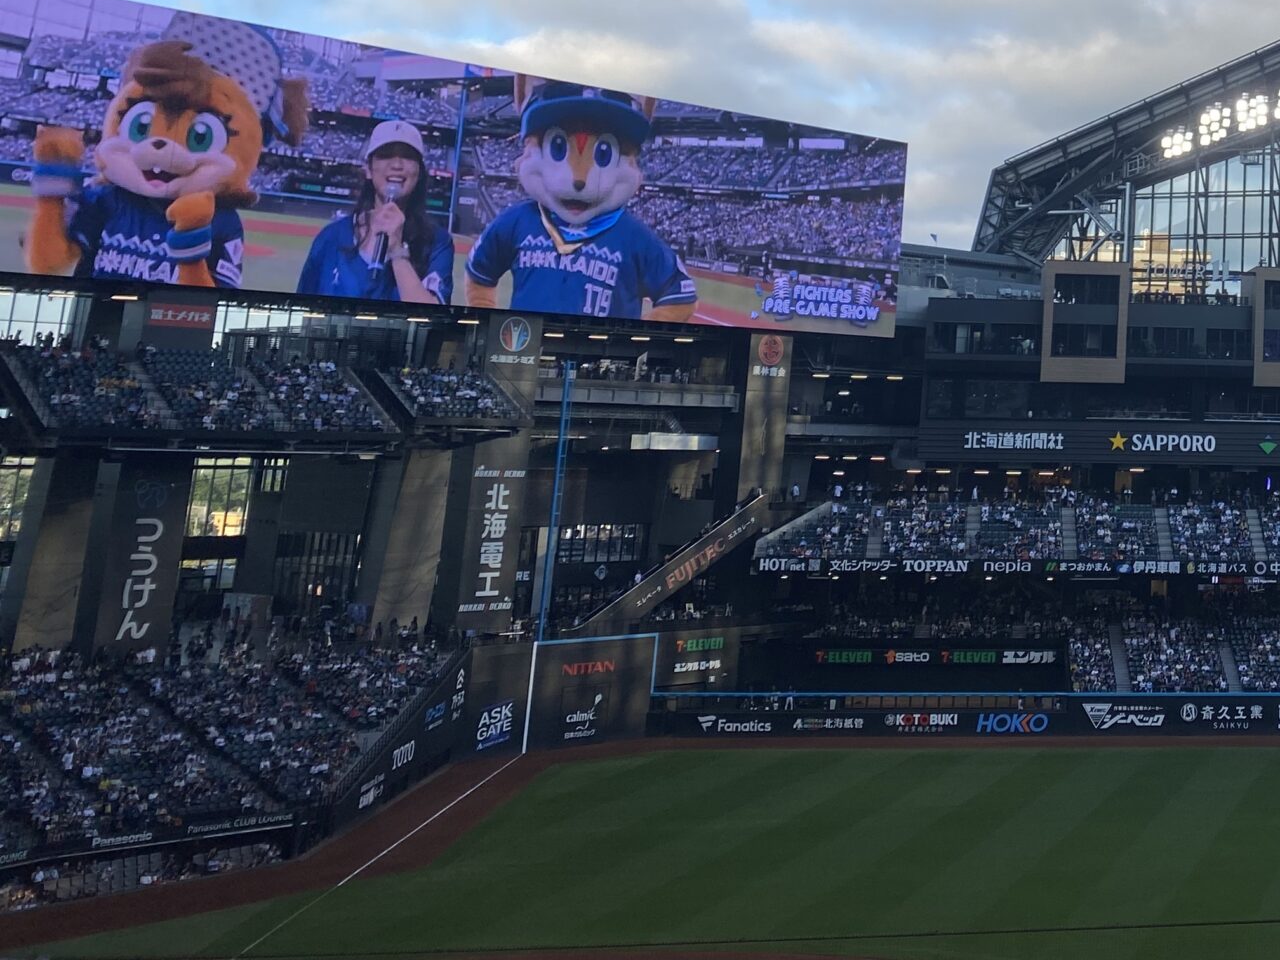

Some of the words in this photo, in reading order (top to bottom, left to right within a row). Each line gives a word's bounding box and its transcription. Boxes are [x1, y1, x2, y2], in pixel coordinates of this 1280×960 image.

[1143, 262, 1206, 280] TOWER
[582, 282, 613, 318] 179
[792, 284, 853, 304] FIGHTERS
[763, 297, 838, 319] PRE-GAME
[839, 304, 880, 321] SHOW
[963, 431, 1065, 450] 北海道新聞社
[1130, 433, 1217, 453] SAPPORO
[475, 482, 511, 598] 北海電工
[665, 536, 726, 590] FUJITEC
[759, 558, 788, 572] HOT
[902, 559, 969, 573] TOPPAN
[983, 560, 1032, 575] nepia
[1058, 561, 1112, 573] まつおかまん
[1196, 561, 1248, 574] 北海道バス
[115, 517, 164, 641] つうけん
[675, 636, 725, 653] 7-ELEVEN
[815, 650, 873, 664] 7-ELEVEN
[895, 651, 930, 663] sato
[941, 650, 997, 664] 7-ELEVEN
[1001, 650, 1056, 664] ユンケル
[561, 660, 616, 676] NITTAN
[477, 702, 514, 729] ASK
[565, 709, 597, 724] calmic
[895, 713, 958, 726] KOTOBUKI
[1099, 713, 1166, 730] ジーベック
[476, 718, 513, 742] GATE
[717, 718, 772, 733] Fanatics
[1213, 721, 1249, 730] SAIKYU
[391, 739, 416, 771] TOTO
[187, 820, 232, 835] Panasonic
[233, 815, 256, 828] CLUB
[91, 829, 153, 848] Panasonic
